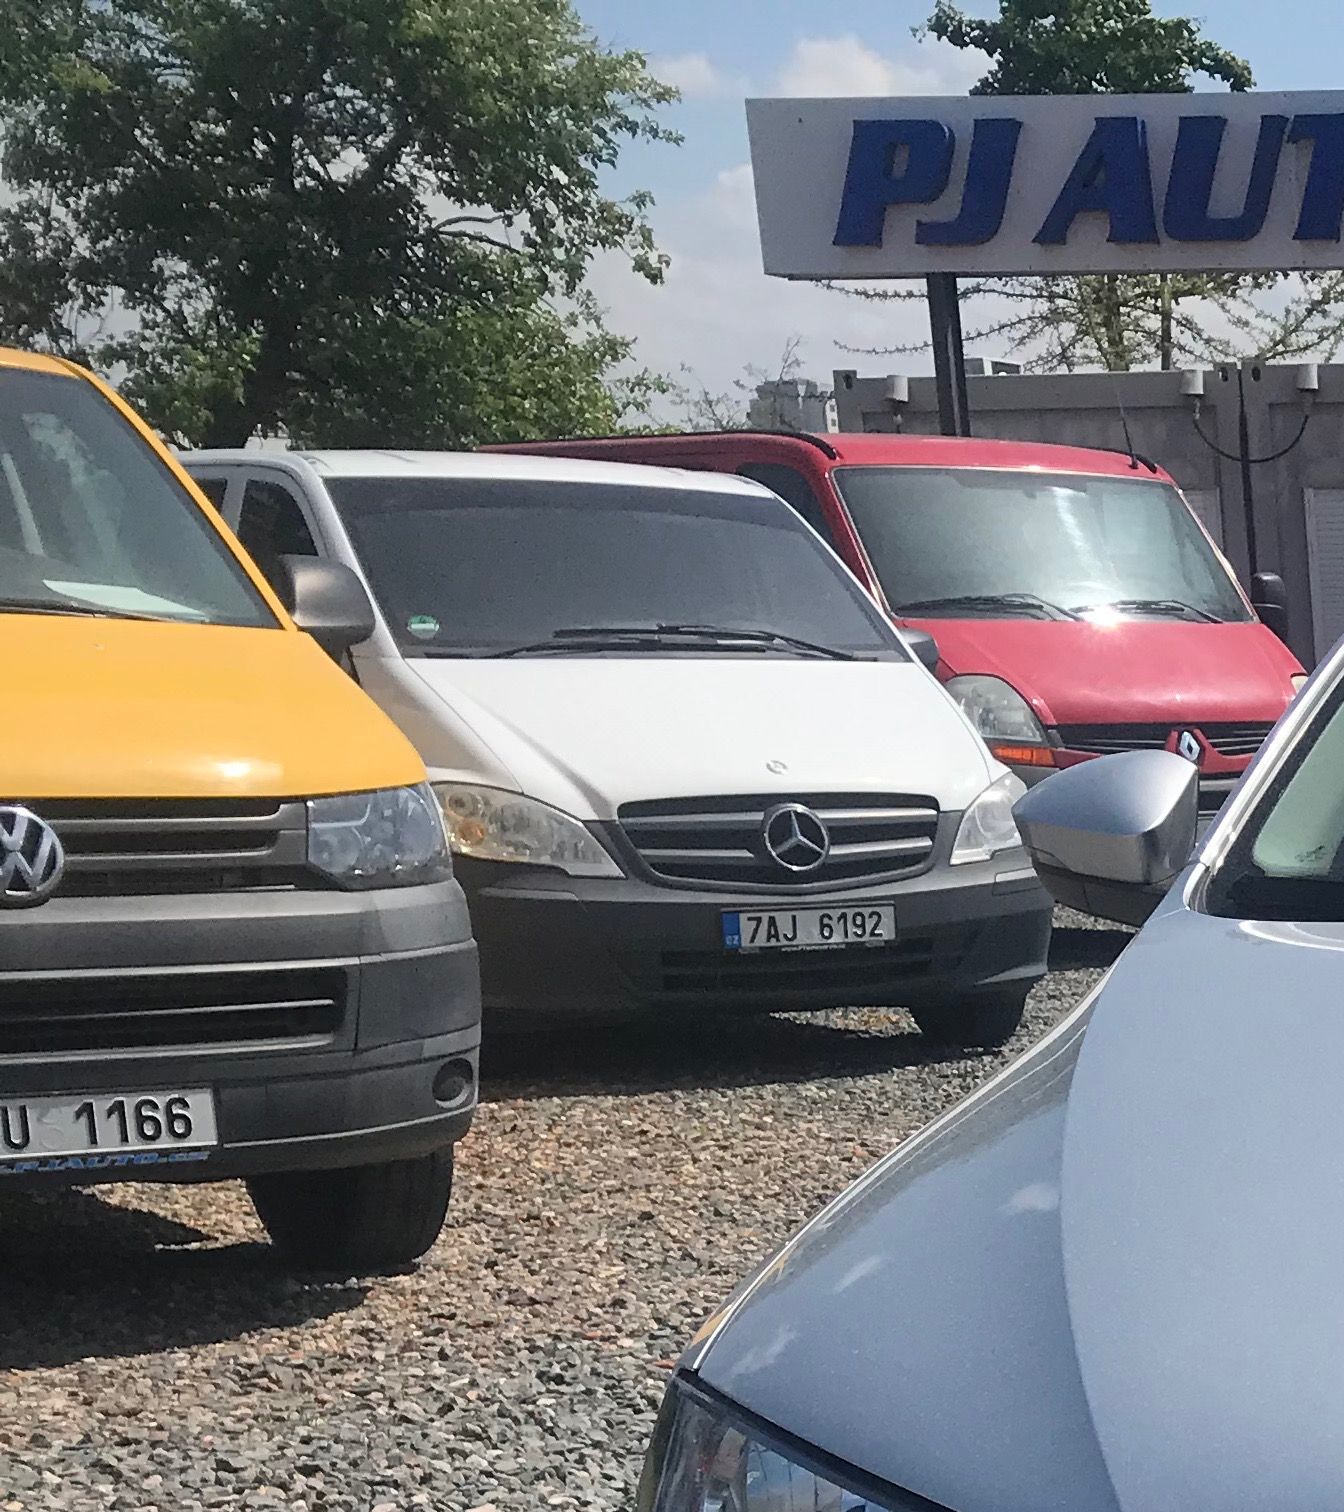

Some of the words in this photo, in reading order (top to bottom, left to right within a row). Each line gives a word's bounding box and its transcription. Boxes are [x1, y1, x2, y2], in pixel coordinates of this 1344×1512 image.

[832, 116, 1023, 247] PJ
[747, 914, 797, 944] 7AJ
[819, 911, 883, 941] 6192
[73, 1096, 192, 1145] 1166
